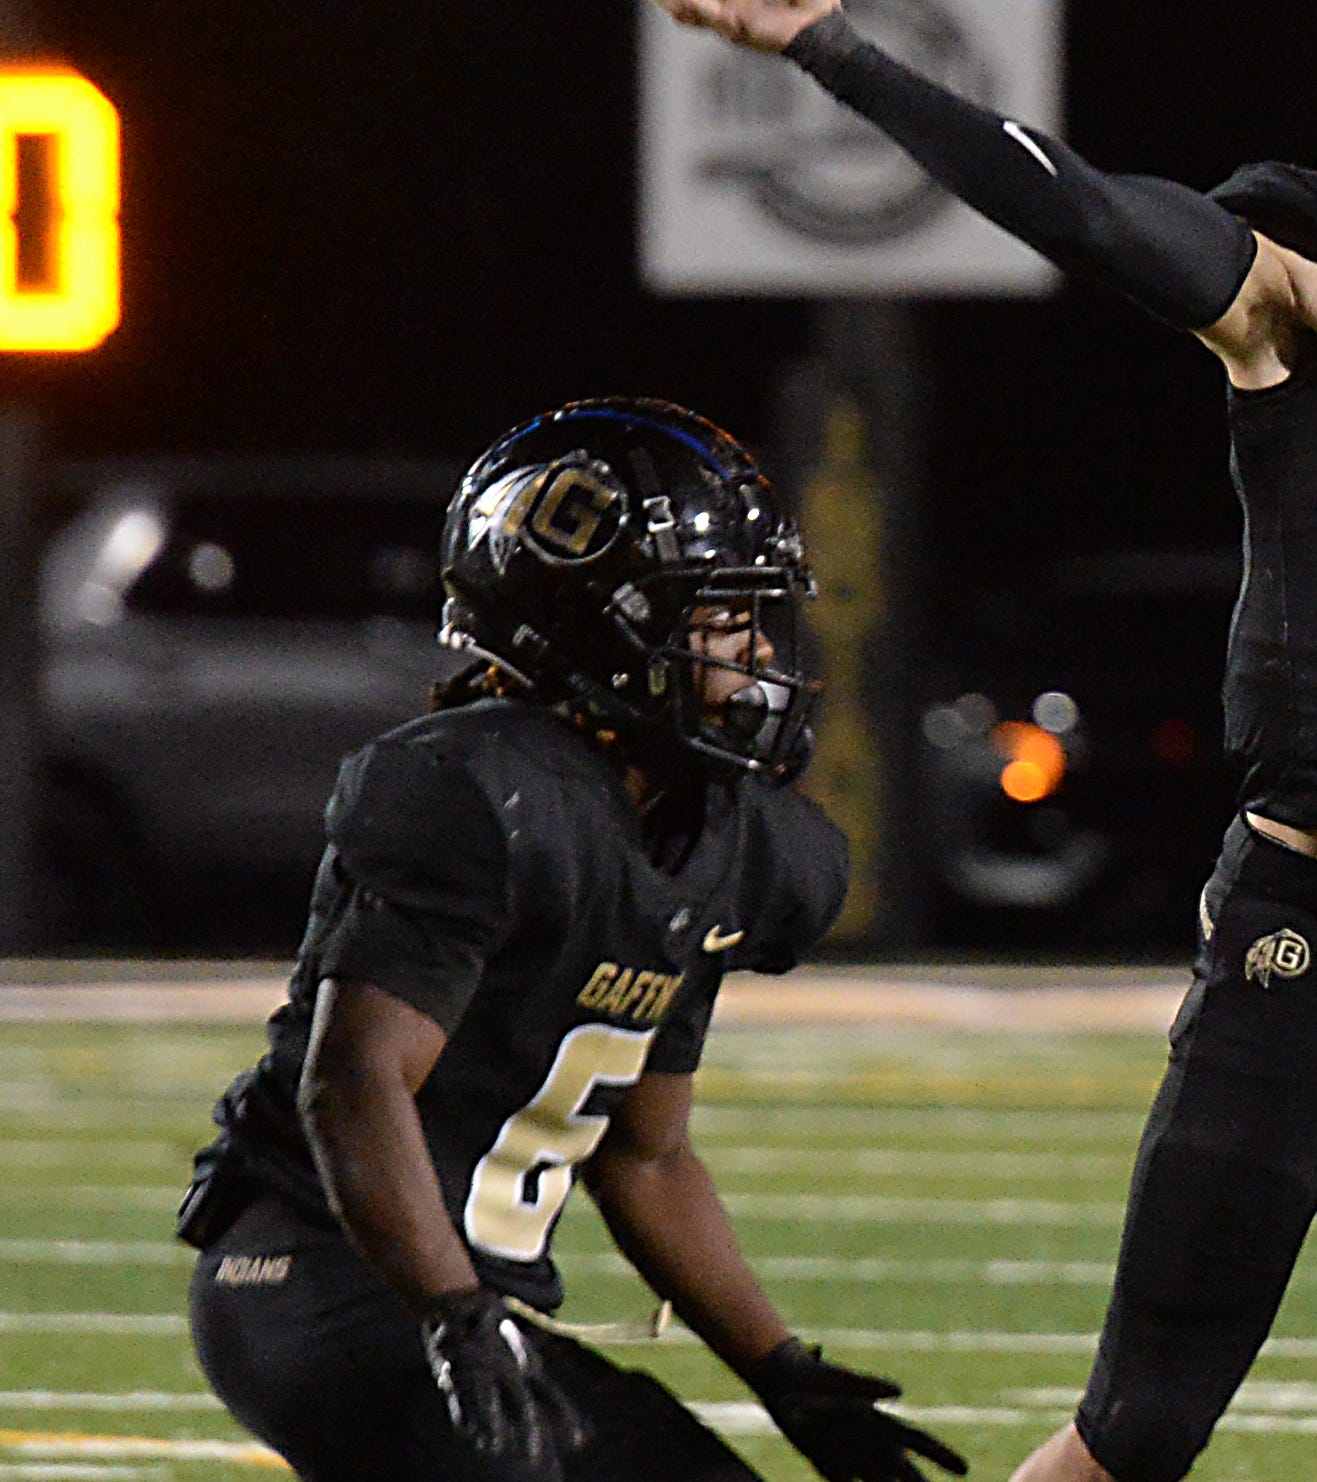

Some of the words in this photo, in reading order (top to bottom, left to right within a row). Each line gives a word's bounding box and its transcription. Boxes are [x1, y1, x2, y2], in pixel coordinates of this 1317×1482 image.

[0, 68, 121, 352] 0
[1276, 939, 1303, 969] G
[463, 1022, 657, 1263] 6
